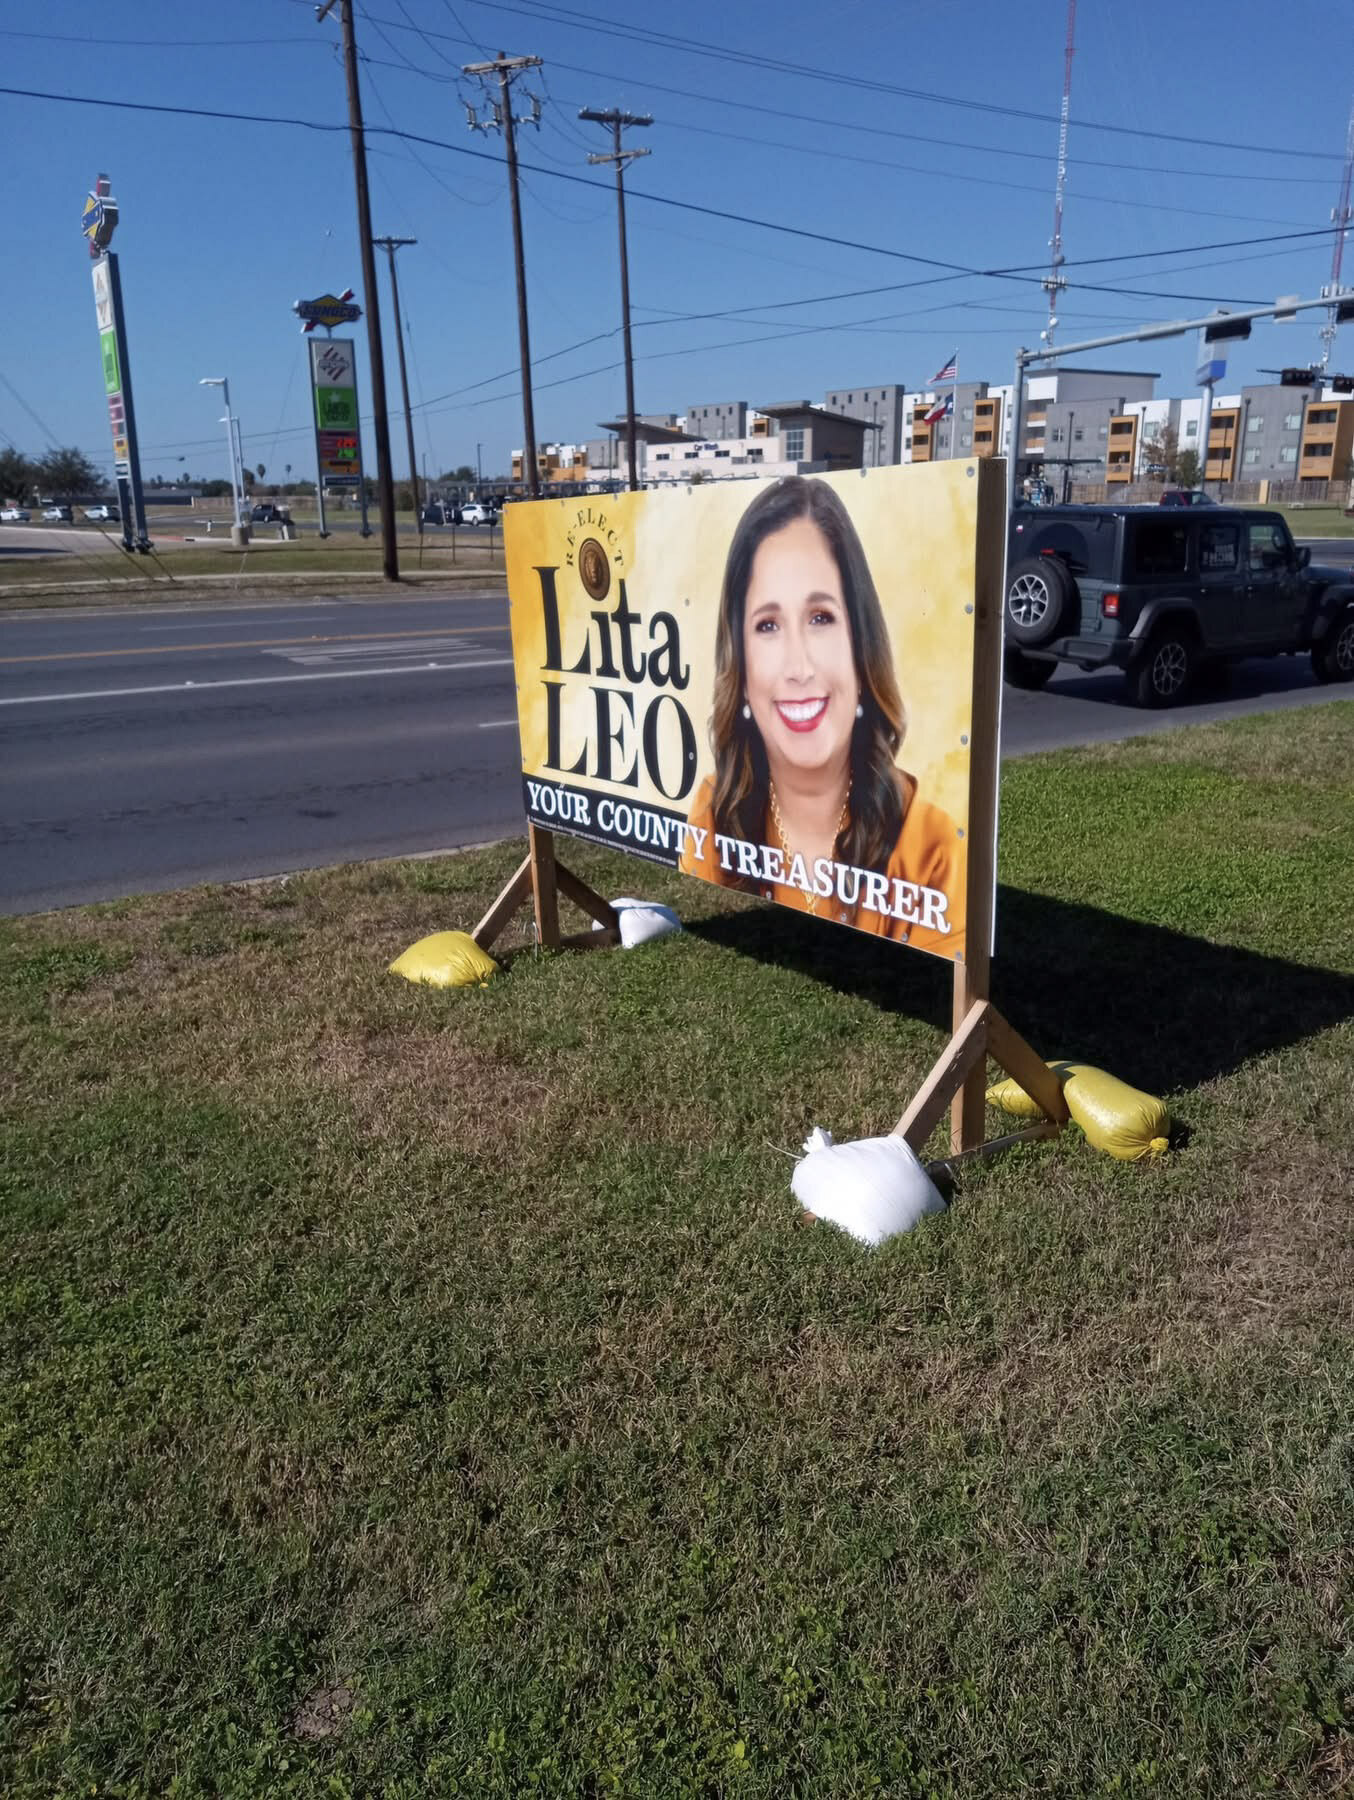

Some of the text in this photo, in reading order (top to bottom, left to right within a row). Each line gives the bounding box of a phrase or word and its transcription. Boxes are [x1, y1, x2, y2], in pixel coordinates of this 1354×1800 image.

[566, 508, 624, 566] RE-ELECT
[533, 566, 690, 690] Lita
[541, 680, 698, 801] LEO
[527, 781, 591, 826] YOUR
[597, 800, 709, 861] COUNTY
[715, 833, 951, 933] TREASURER
